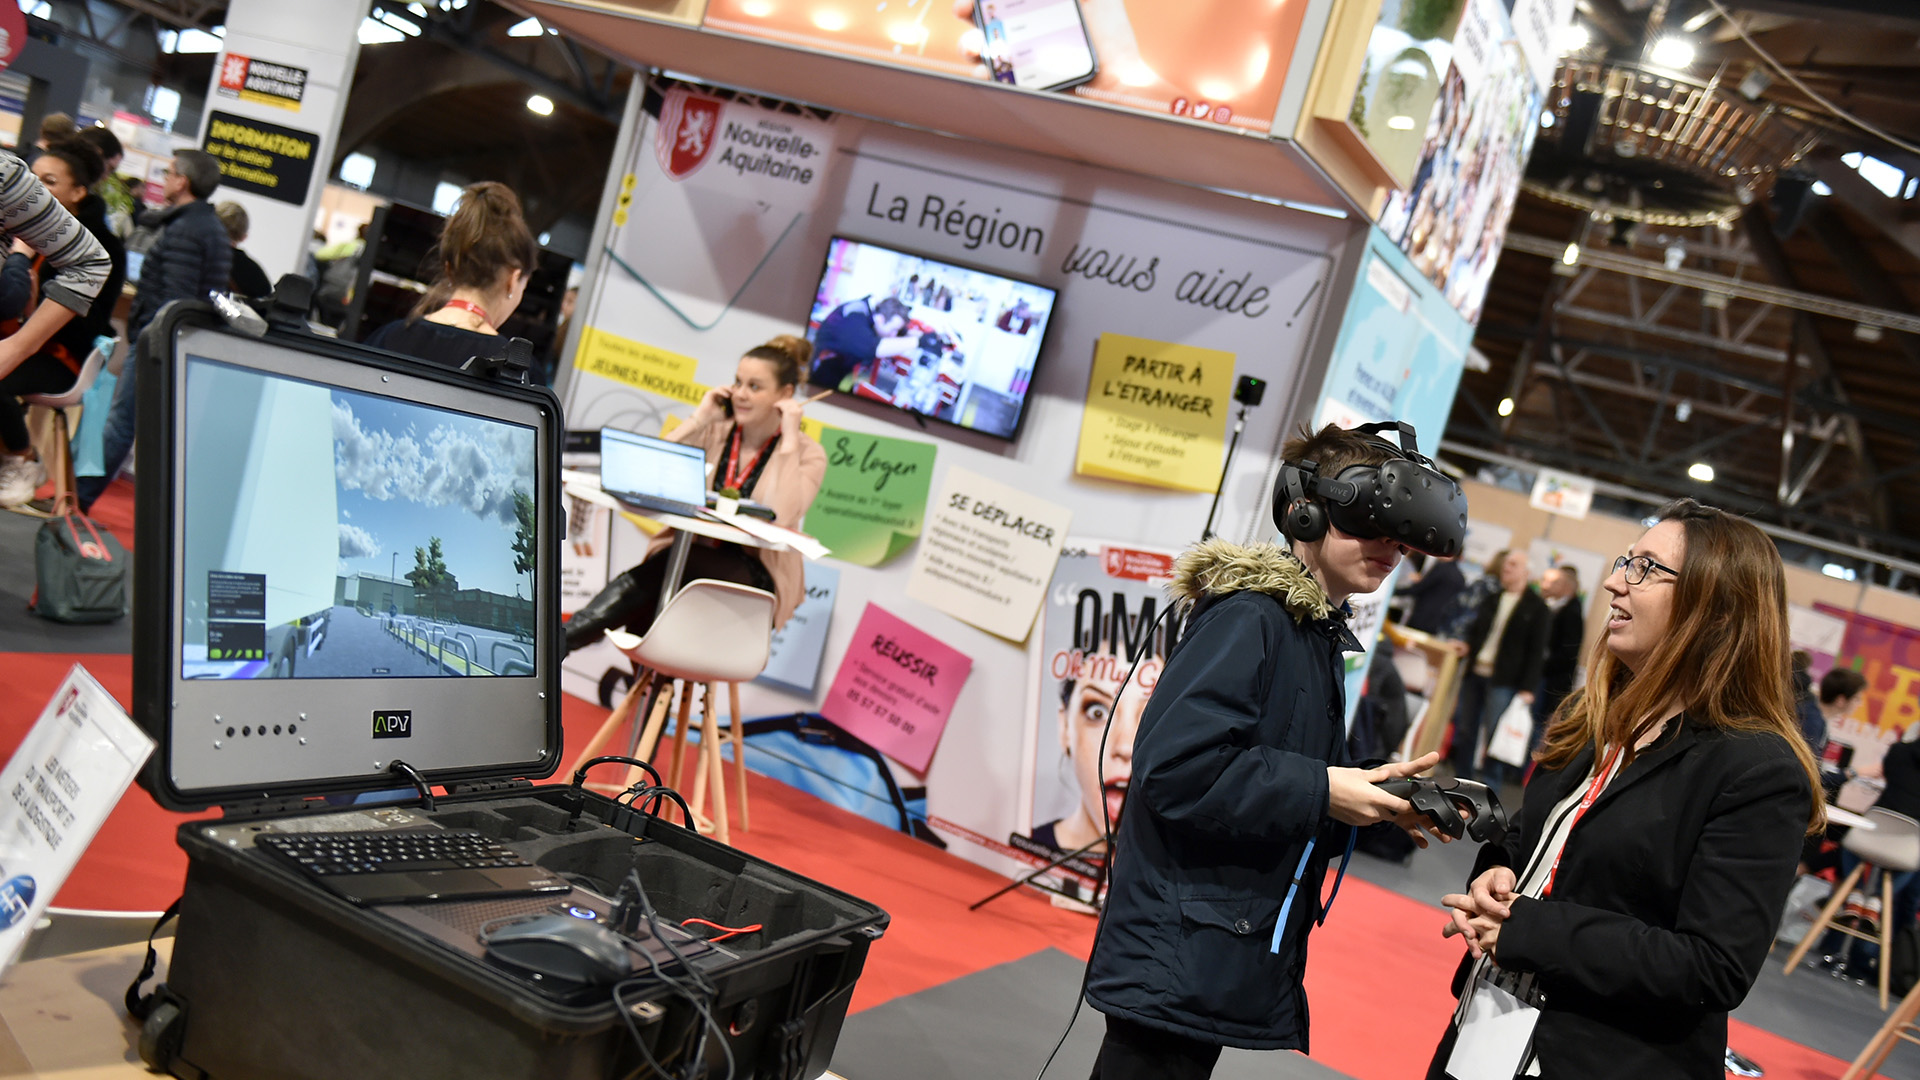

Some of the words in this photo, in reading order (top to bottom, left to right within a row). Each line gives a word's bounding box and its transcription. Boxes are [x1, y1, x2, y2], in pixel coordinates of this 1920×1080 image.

[209, 118, 311, 160] INFORMATION
[723, 121, 820, 158] Nouvelle-
[228, 161, 279, 188] formations
[719, 147, 814, 184] Aquitaine
[866, 181, 908, 223] La
[918, 193, 1044, 255] Région
[1061, 243, 1159, 292] vous
[1175, 268, 1270, 317] aide
[1122, 354, 1185, 384] PARTIR
[1102, 377, 1214, 418] L'ÉTRANGER
[829, 436, 855, 467] Se
[860, 440, 917, 492] loger
[1330, 485, 1348, 497] VIVE
[948, 492, 970, 511] SE
[972, 500, 1056, 547] DÉPLACER
[871, 633, 939, 687] RÉUSSIR
[25, 764, 36, 783] DU
[34, 775, 69, 817] TRANSPORT
[45, 756, 59, 774] LES
[54, 766, 81, 801] MÉTIERS
[26, 801, 62, 851] LOGISTIQUE
